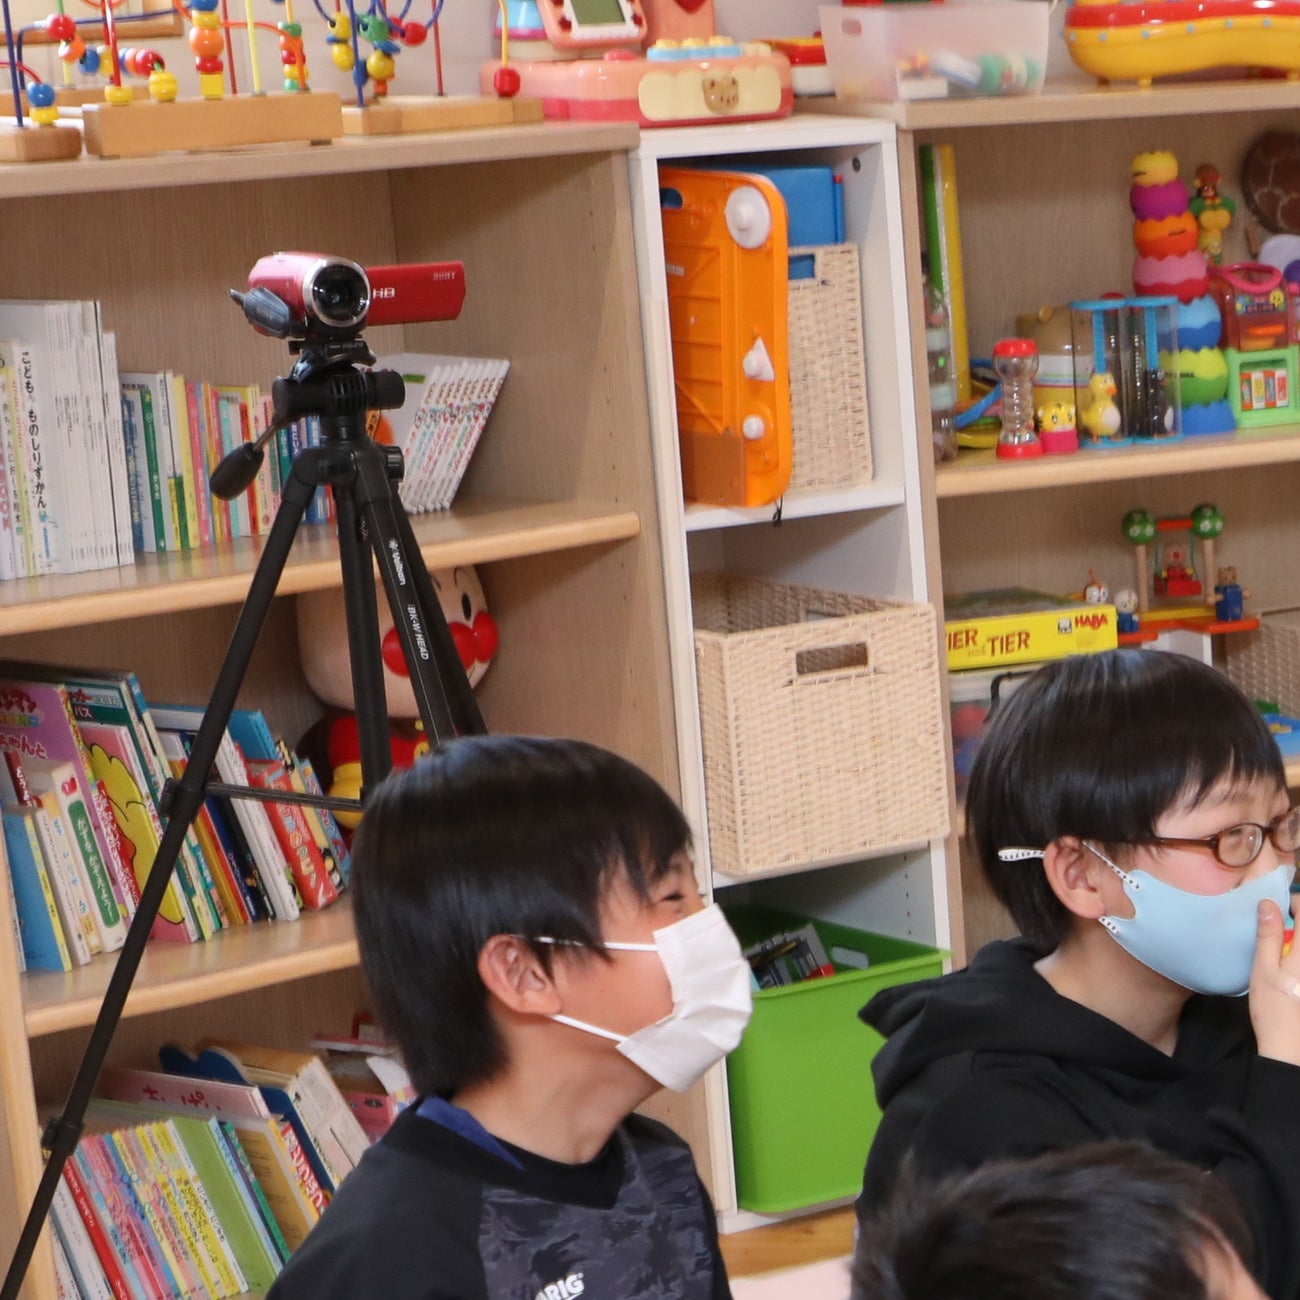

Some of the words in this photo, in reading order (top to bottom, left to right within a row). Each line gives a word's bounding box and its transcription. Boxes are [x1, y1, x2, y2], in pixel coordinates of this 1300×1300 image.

[1074, 613, 1109, 631] HABA
[415, 632, 430, 661] HEAD
[946, 628, 979, 652] IER
[986, 631, 1031, 657] TIER
